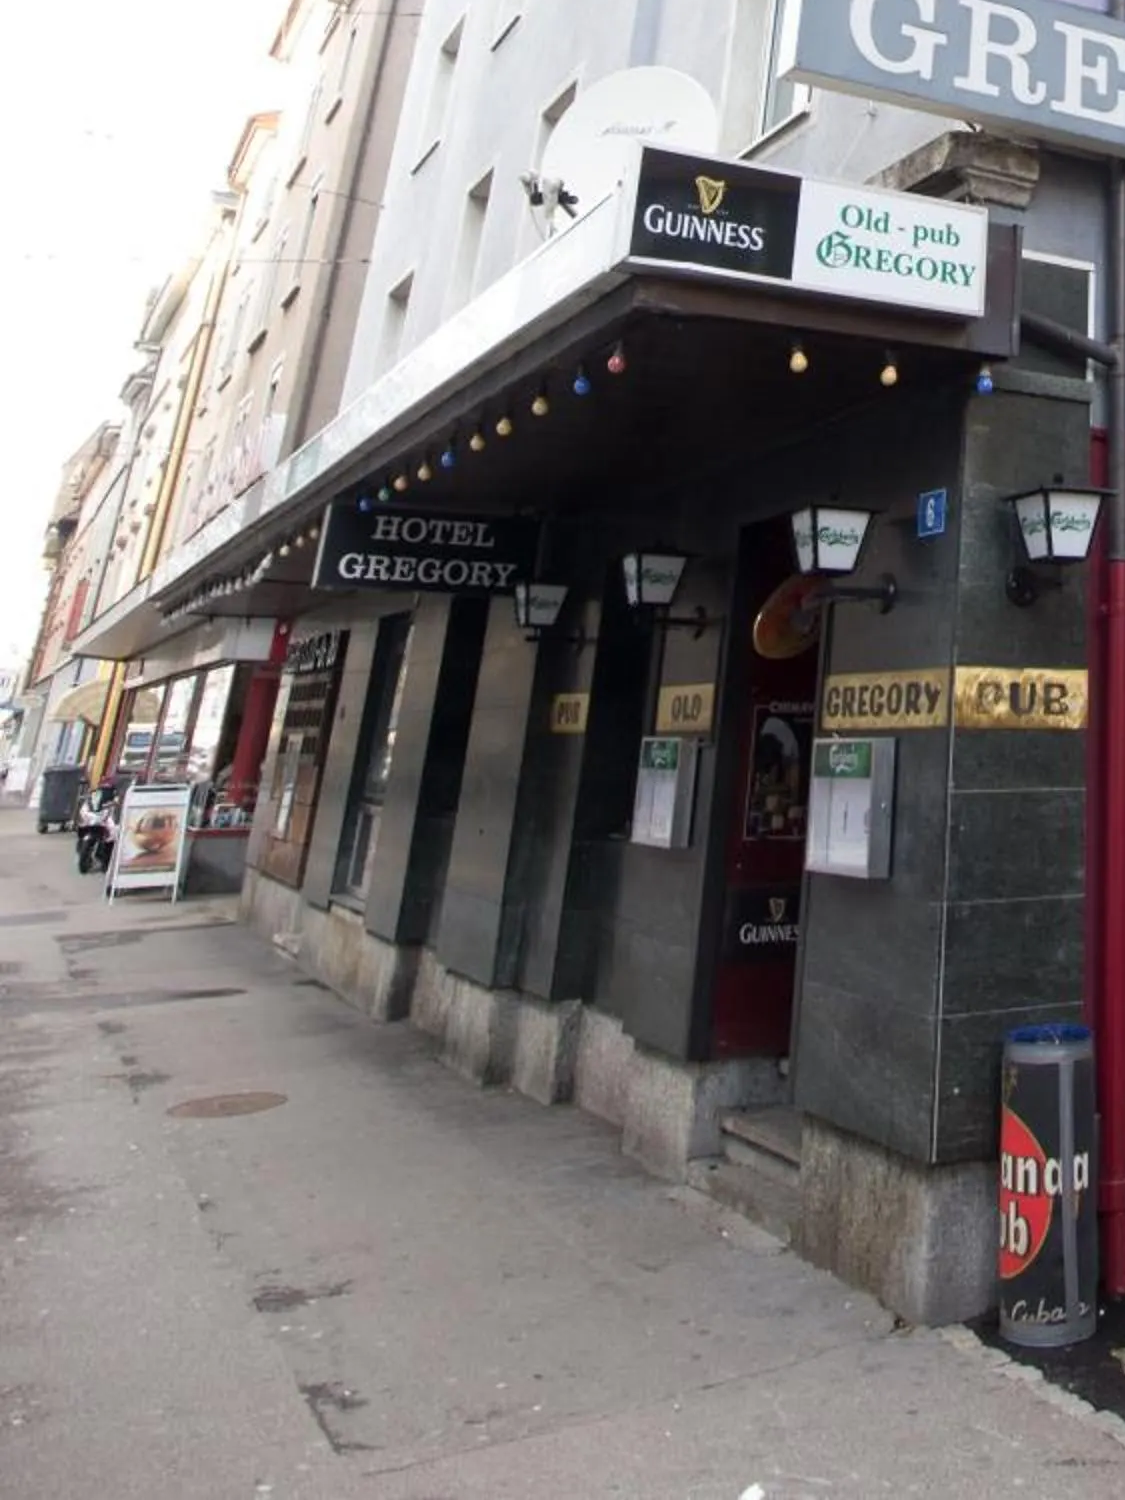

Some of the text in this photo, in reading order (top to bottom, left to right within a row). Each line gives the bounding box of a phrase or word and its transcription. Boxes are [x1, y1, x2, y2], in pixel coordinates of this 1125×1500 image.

[643, 203, 764, 251] GUINNESS
[840, 204, 890, 233] Old
[912, 222, 961, 248] pub
[816, 231, 976, 286] GREGORY
[371, 515, 495, 547] HOTEL
[338, 552, 517, 588] GREGORY
[826, 681, 940, 717] GREGORY
[976, 680, 1069, 716] PUB
